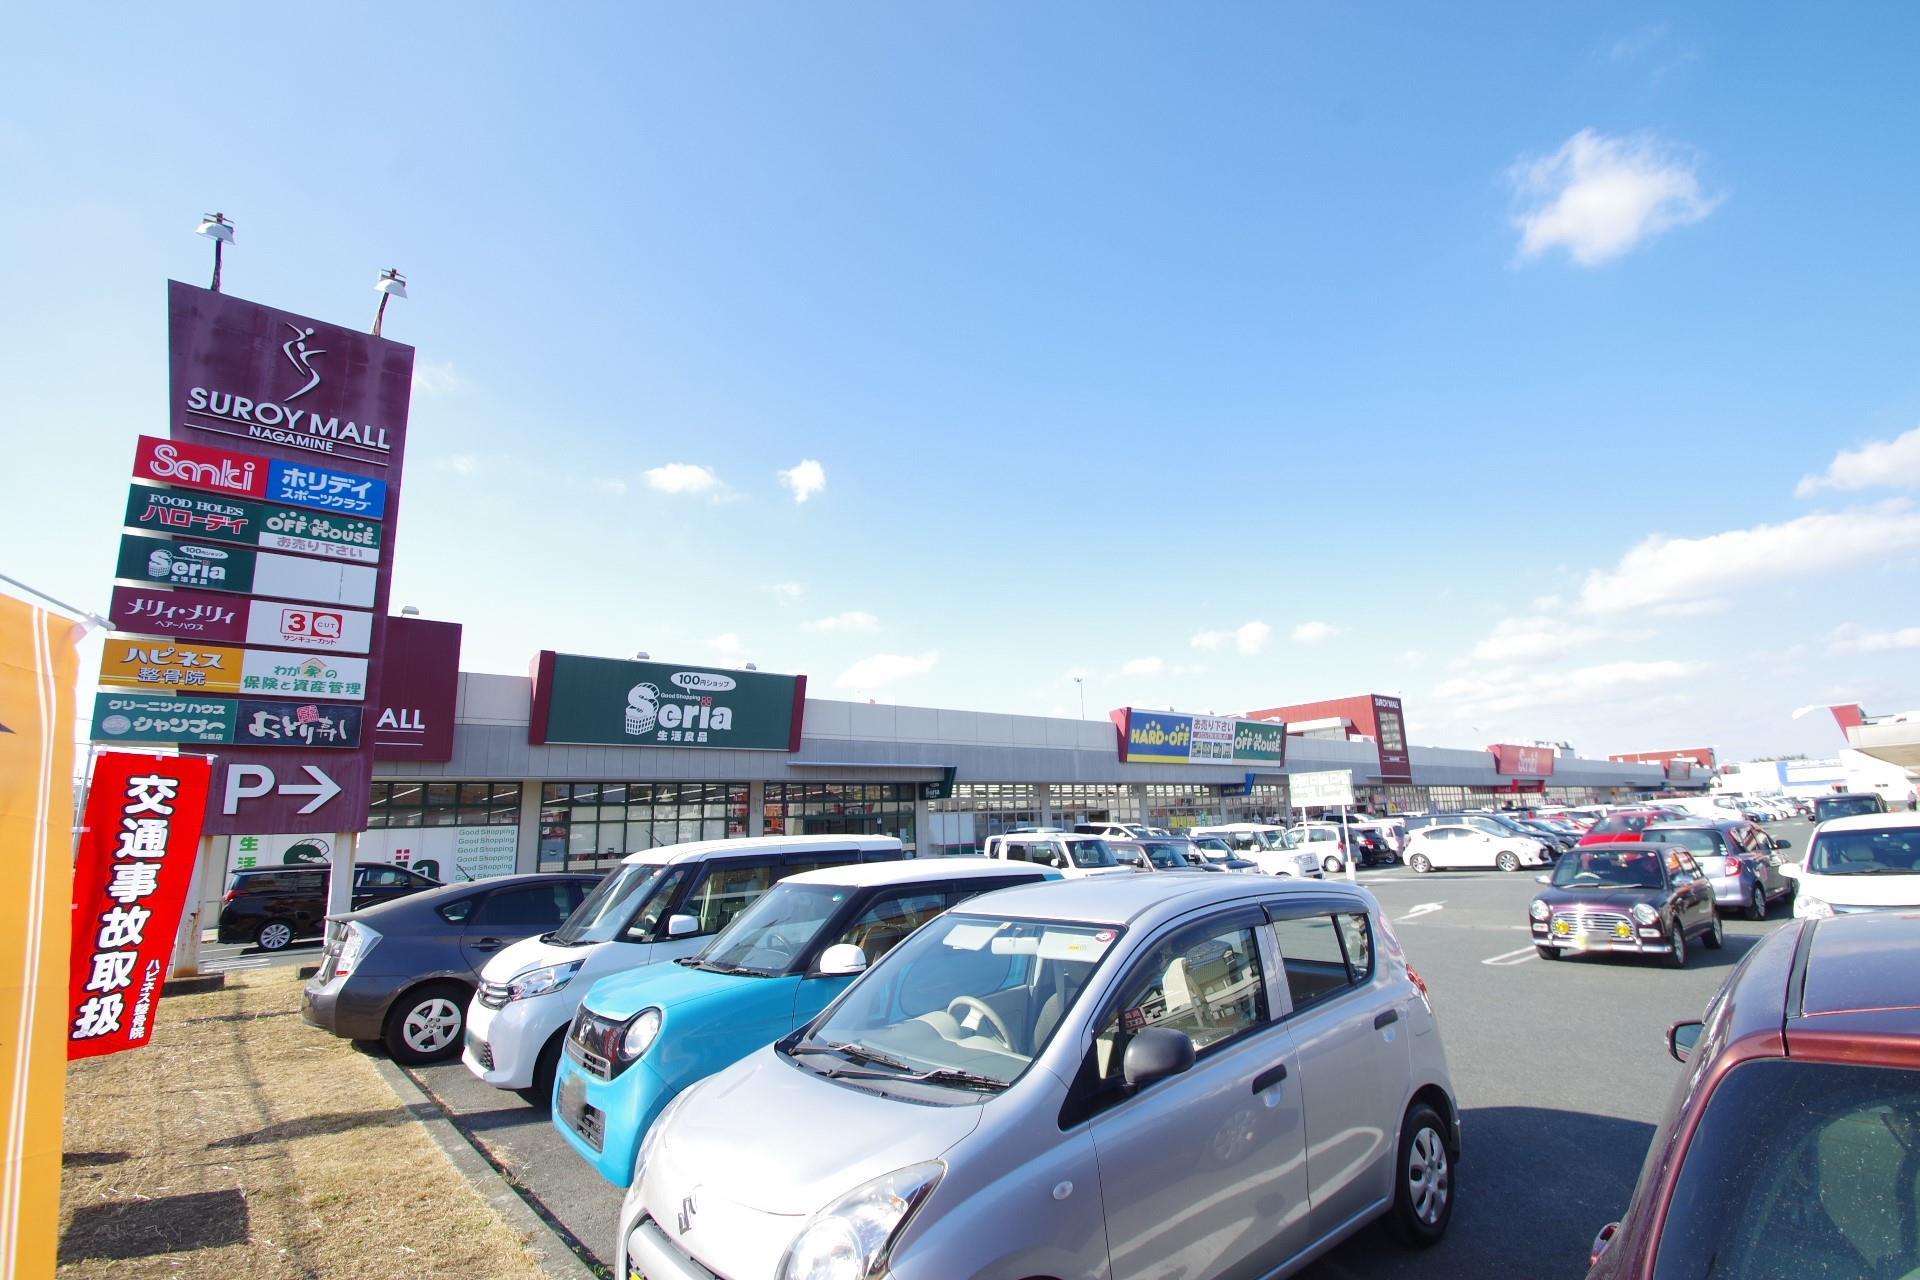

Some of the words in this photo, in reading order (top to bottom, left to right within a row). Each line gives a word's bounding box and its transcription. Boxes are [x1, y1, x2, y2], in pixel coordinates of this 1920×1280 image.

[187, 387, 304, 430] SUROY
[309, 413, 391, 450] MALL
[249, 424, 334, 453] NAGAMINE
[149, 444, 256, 492] Sanki
[281, 467, 374, 499] ホリデイ
[148, 493, 192, 509] FOOD
[196, 501, 244, 517] HOLES
[279, 487, 372, 512] スポーツクラブ
[266, 514, 307, 535] OFF
[276, 536, 363, 559] お売り下さい
[148, 549, 226, 580] Seria
[317, 621, 336, 629] CUT
[121, 648, 225, 669] ハピネス
[137, 667, 207, 686] 整骨院
[243, 675, 362, 695] 保険と資産管理
[679, 674, 730, 688] 100円ショップ
[626, 682, 733, 736] Seria
[657, 730, 708, 743] 生活良品
[223, 764, 276, 815] P
[72, 774, 178, 1040] 交通事故取扱
